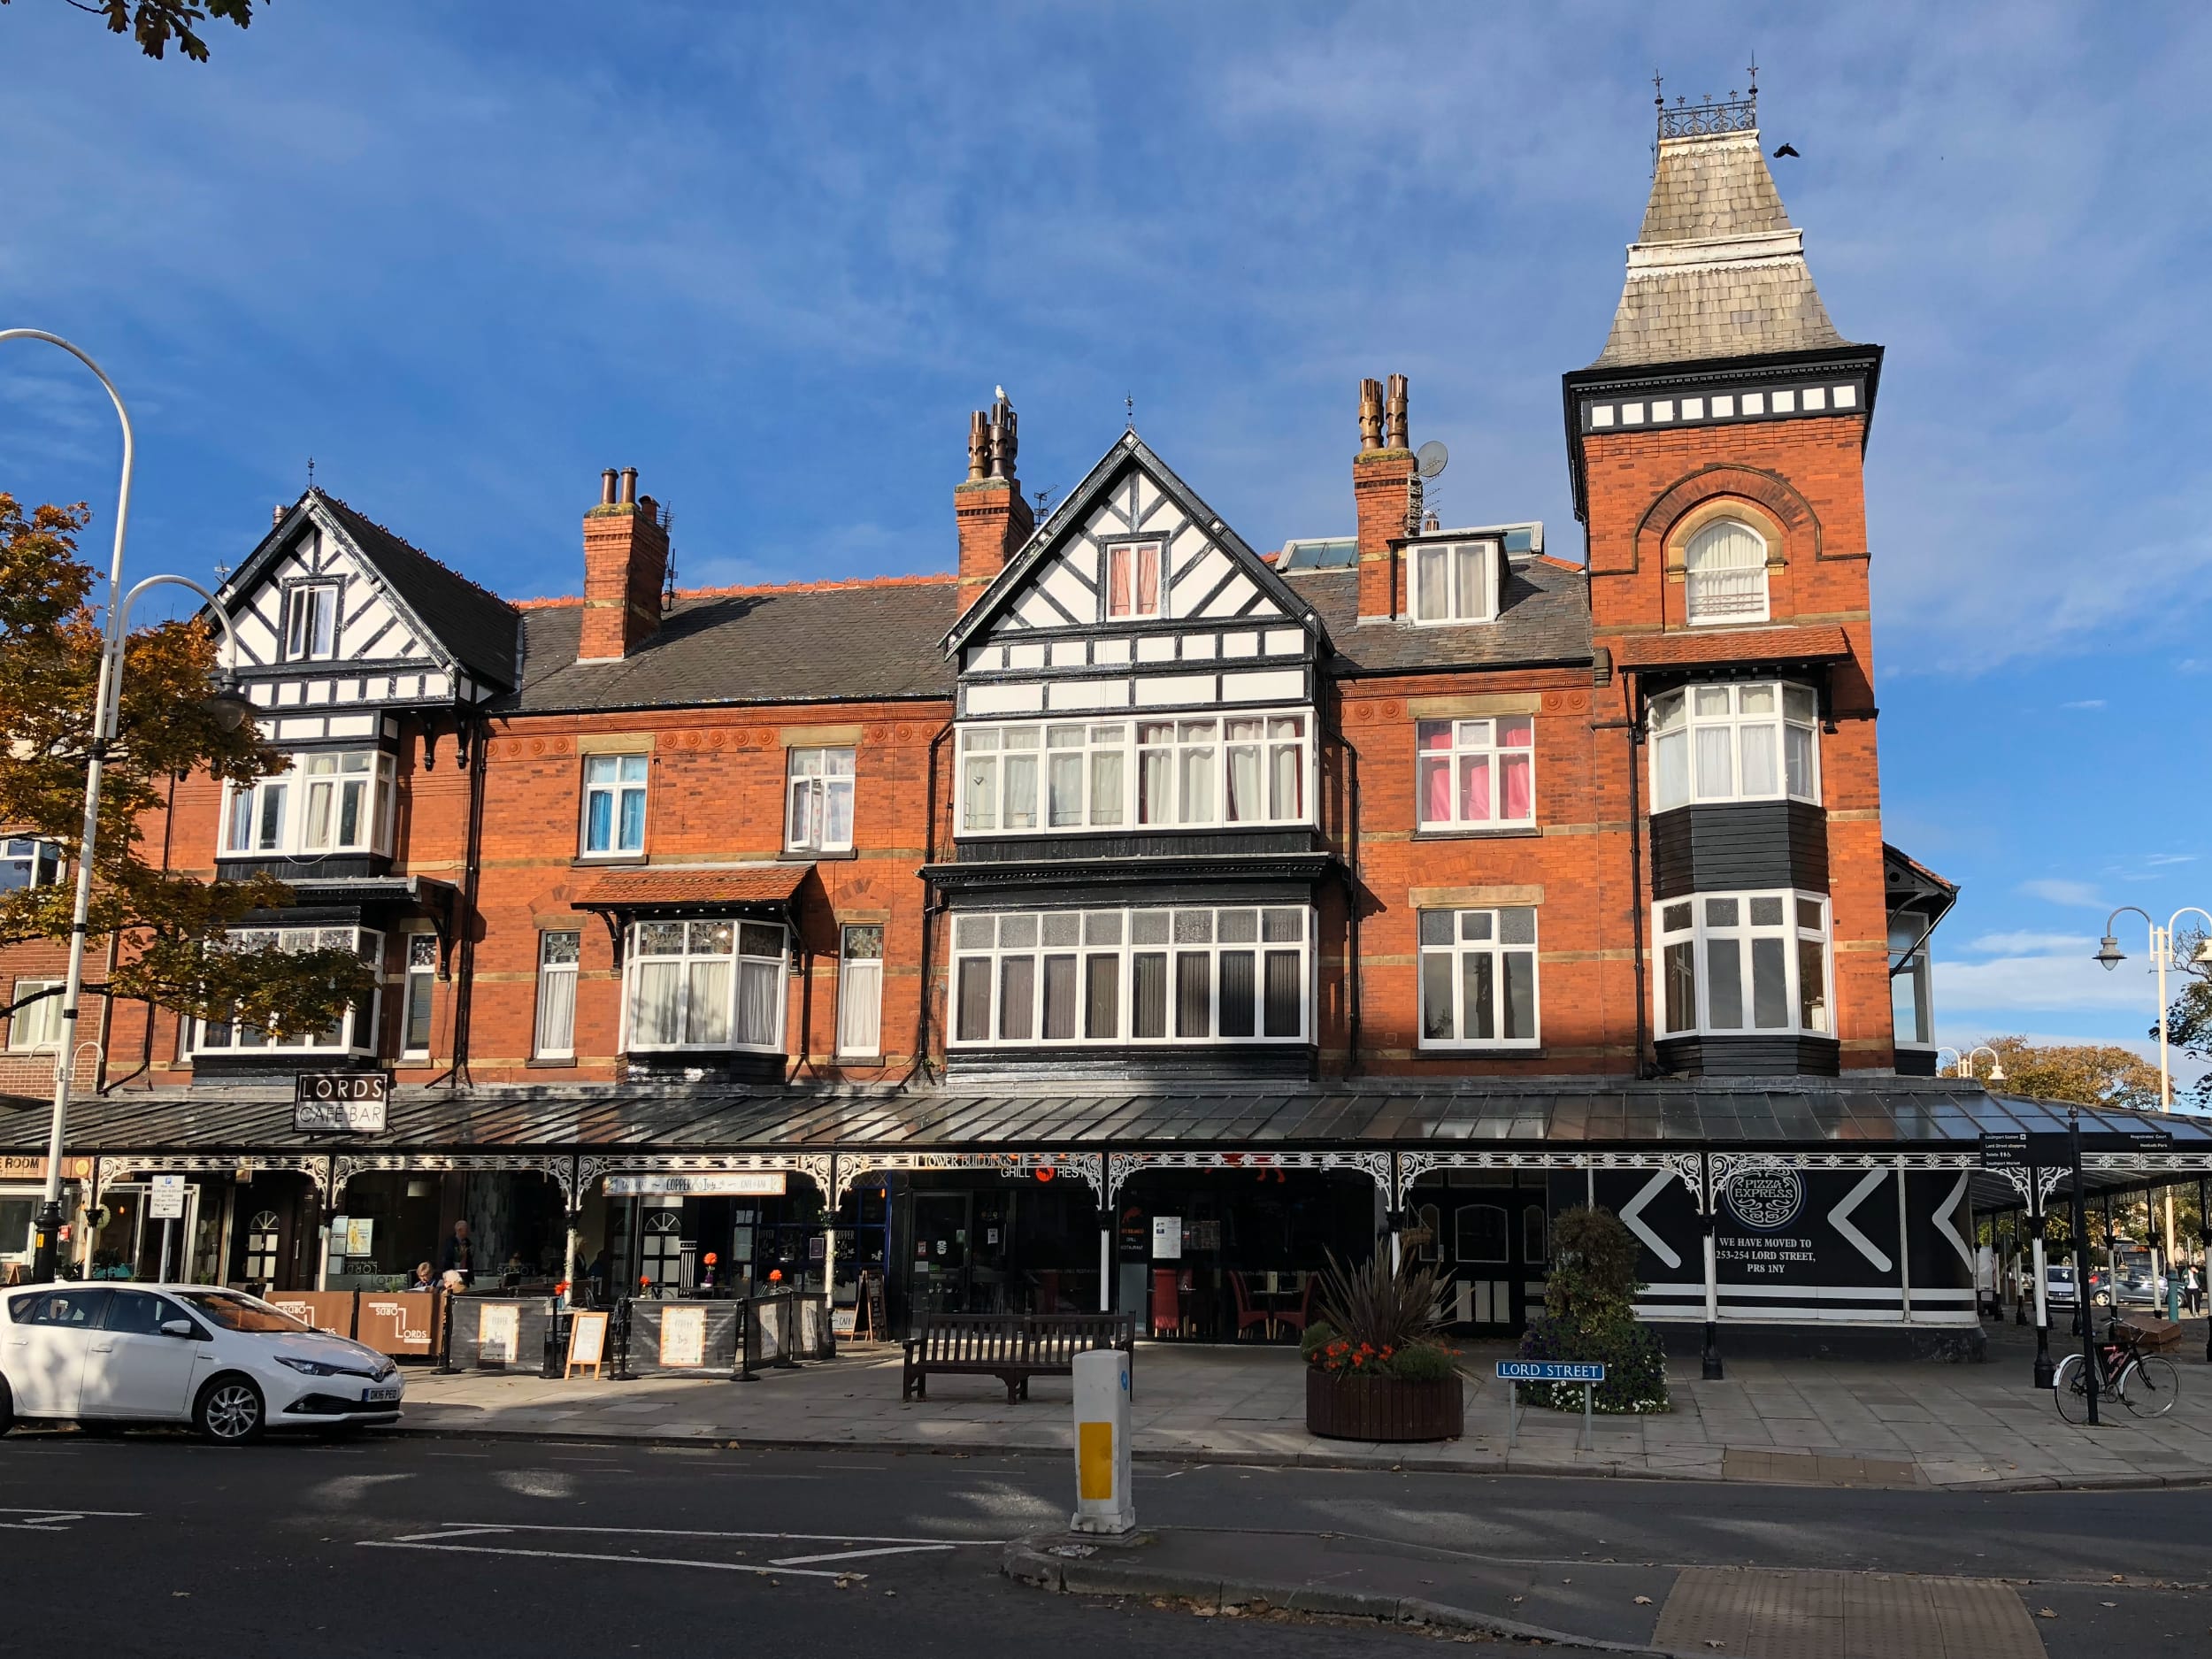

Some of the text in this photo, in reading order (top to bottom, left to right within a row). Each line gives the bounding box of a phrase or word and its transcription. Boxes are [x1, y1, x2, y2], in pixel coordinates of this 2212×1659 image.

[303, 1079, 382, 1098] LORDS
[300, 1102, 382, 1123] CAFÉ BAR
[4, 1157, 40, 1169] ROOM
[925, 1153, 1012, 1166] TOWER BUILDINGS
[1001, 1166, 1031, 1179] GRILL
[666, 1178, 693, 1191] COPPER
[1745, 1179, 1783, 1189] PIZZA
[1734, 1188, 1793, 1198] EXPRESS
[1719, 1238, 1812, 1248] WE HAVE MOVED TO
[1716, 1250, 1816, 1263] 253-254 LORD STREET,
[1747, 1263, 1786, 1273] PR8 1NY
[1502, 1363, 1599, 1378] LORD STREET
